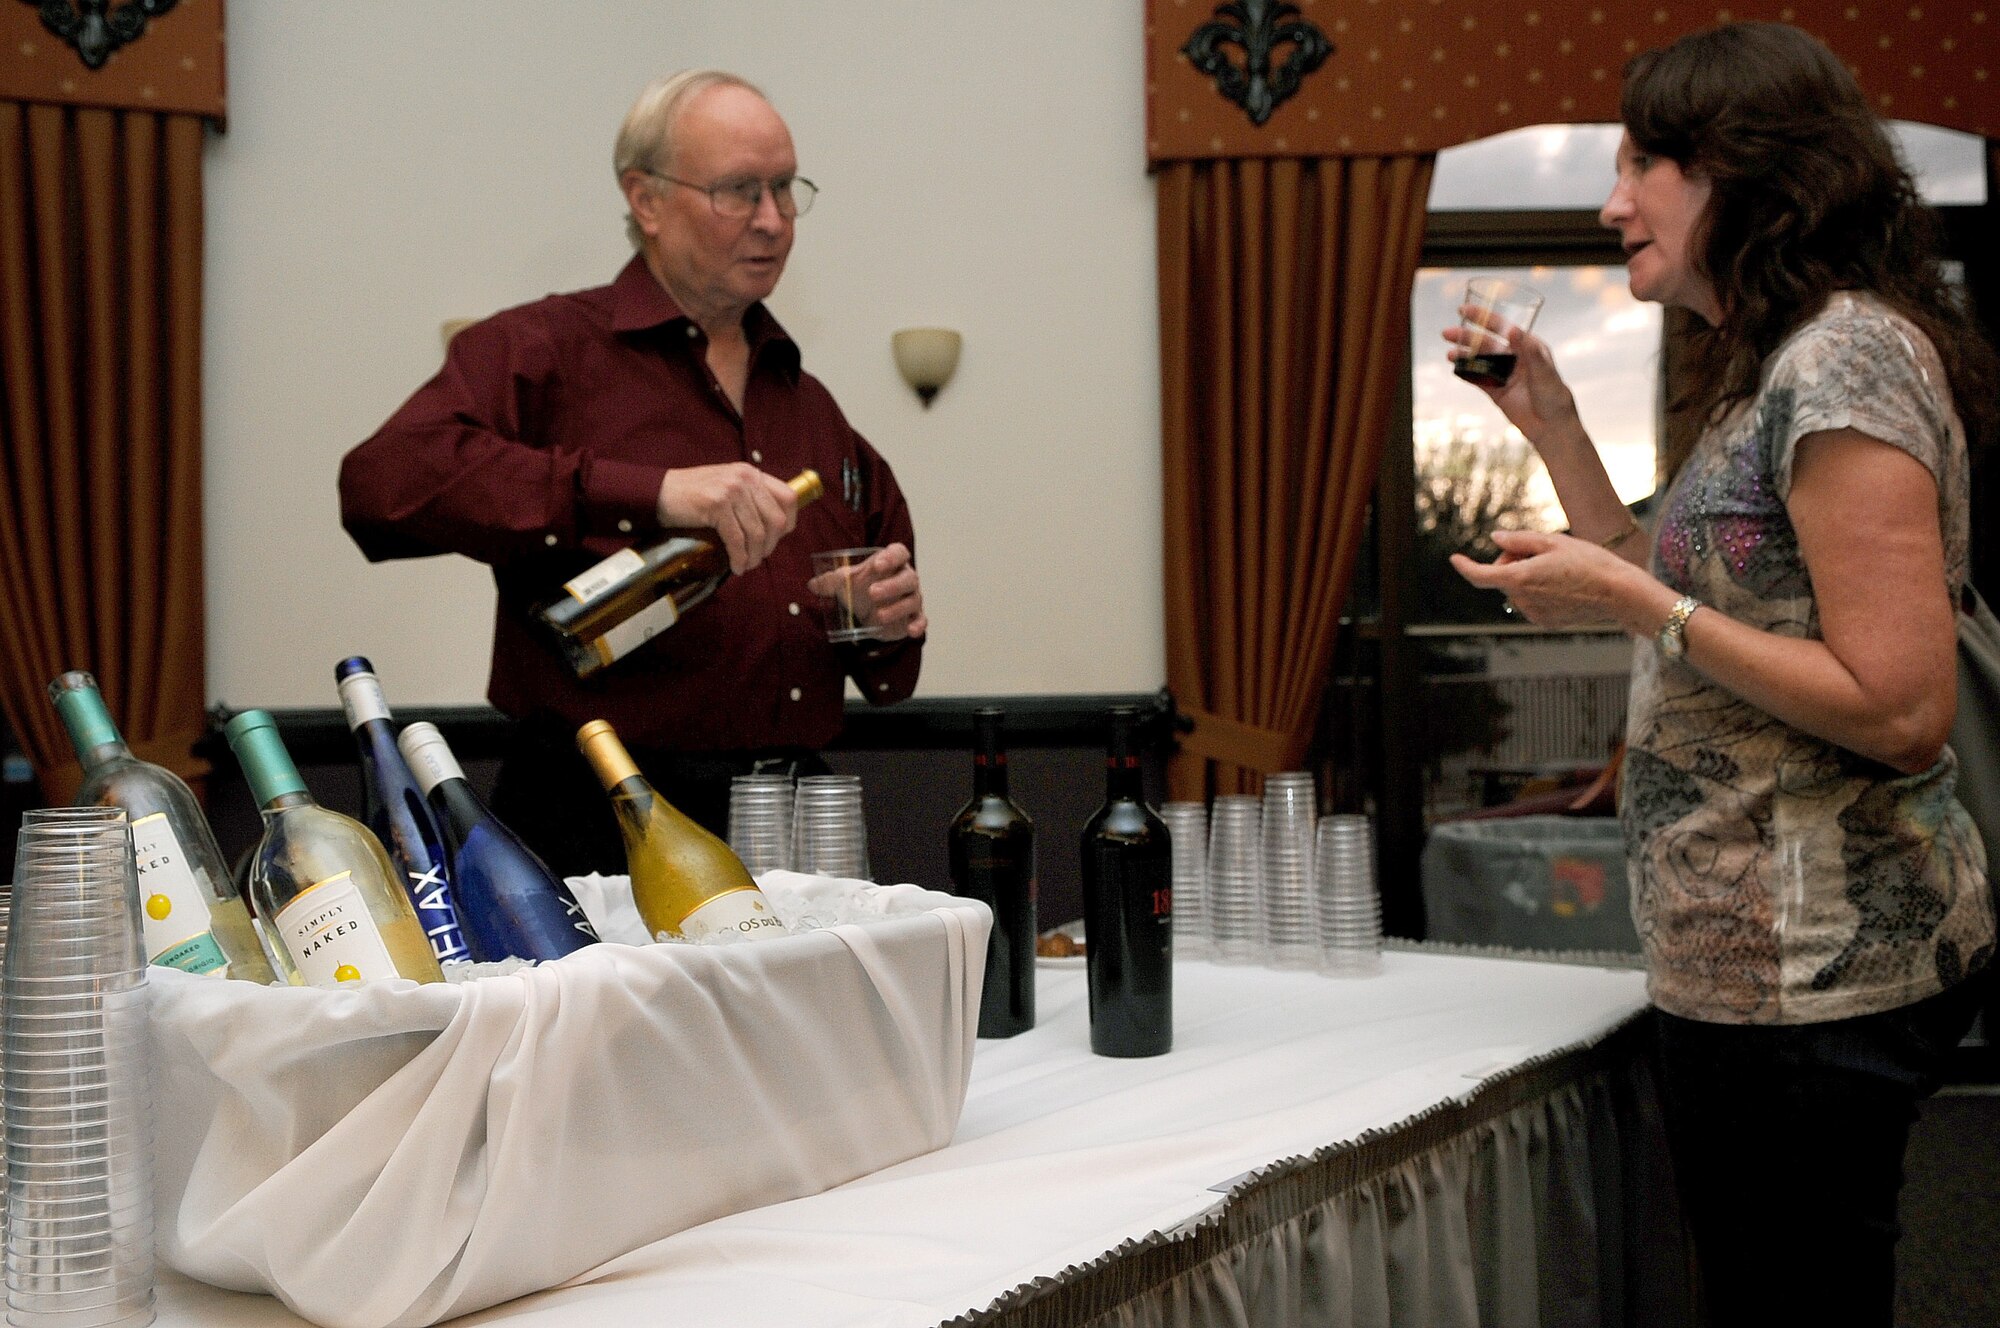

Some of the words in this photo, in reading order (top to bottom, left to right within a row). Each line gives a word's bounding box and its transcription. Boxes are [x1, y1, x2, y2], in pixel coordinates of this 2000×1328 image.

[137, 856, 170, 875] KED
[298, 905, 343, 937] SIMPLY
[303, 920, 358, 958] NAKED
[164, 944, 200, 966] UNOAKED
